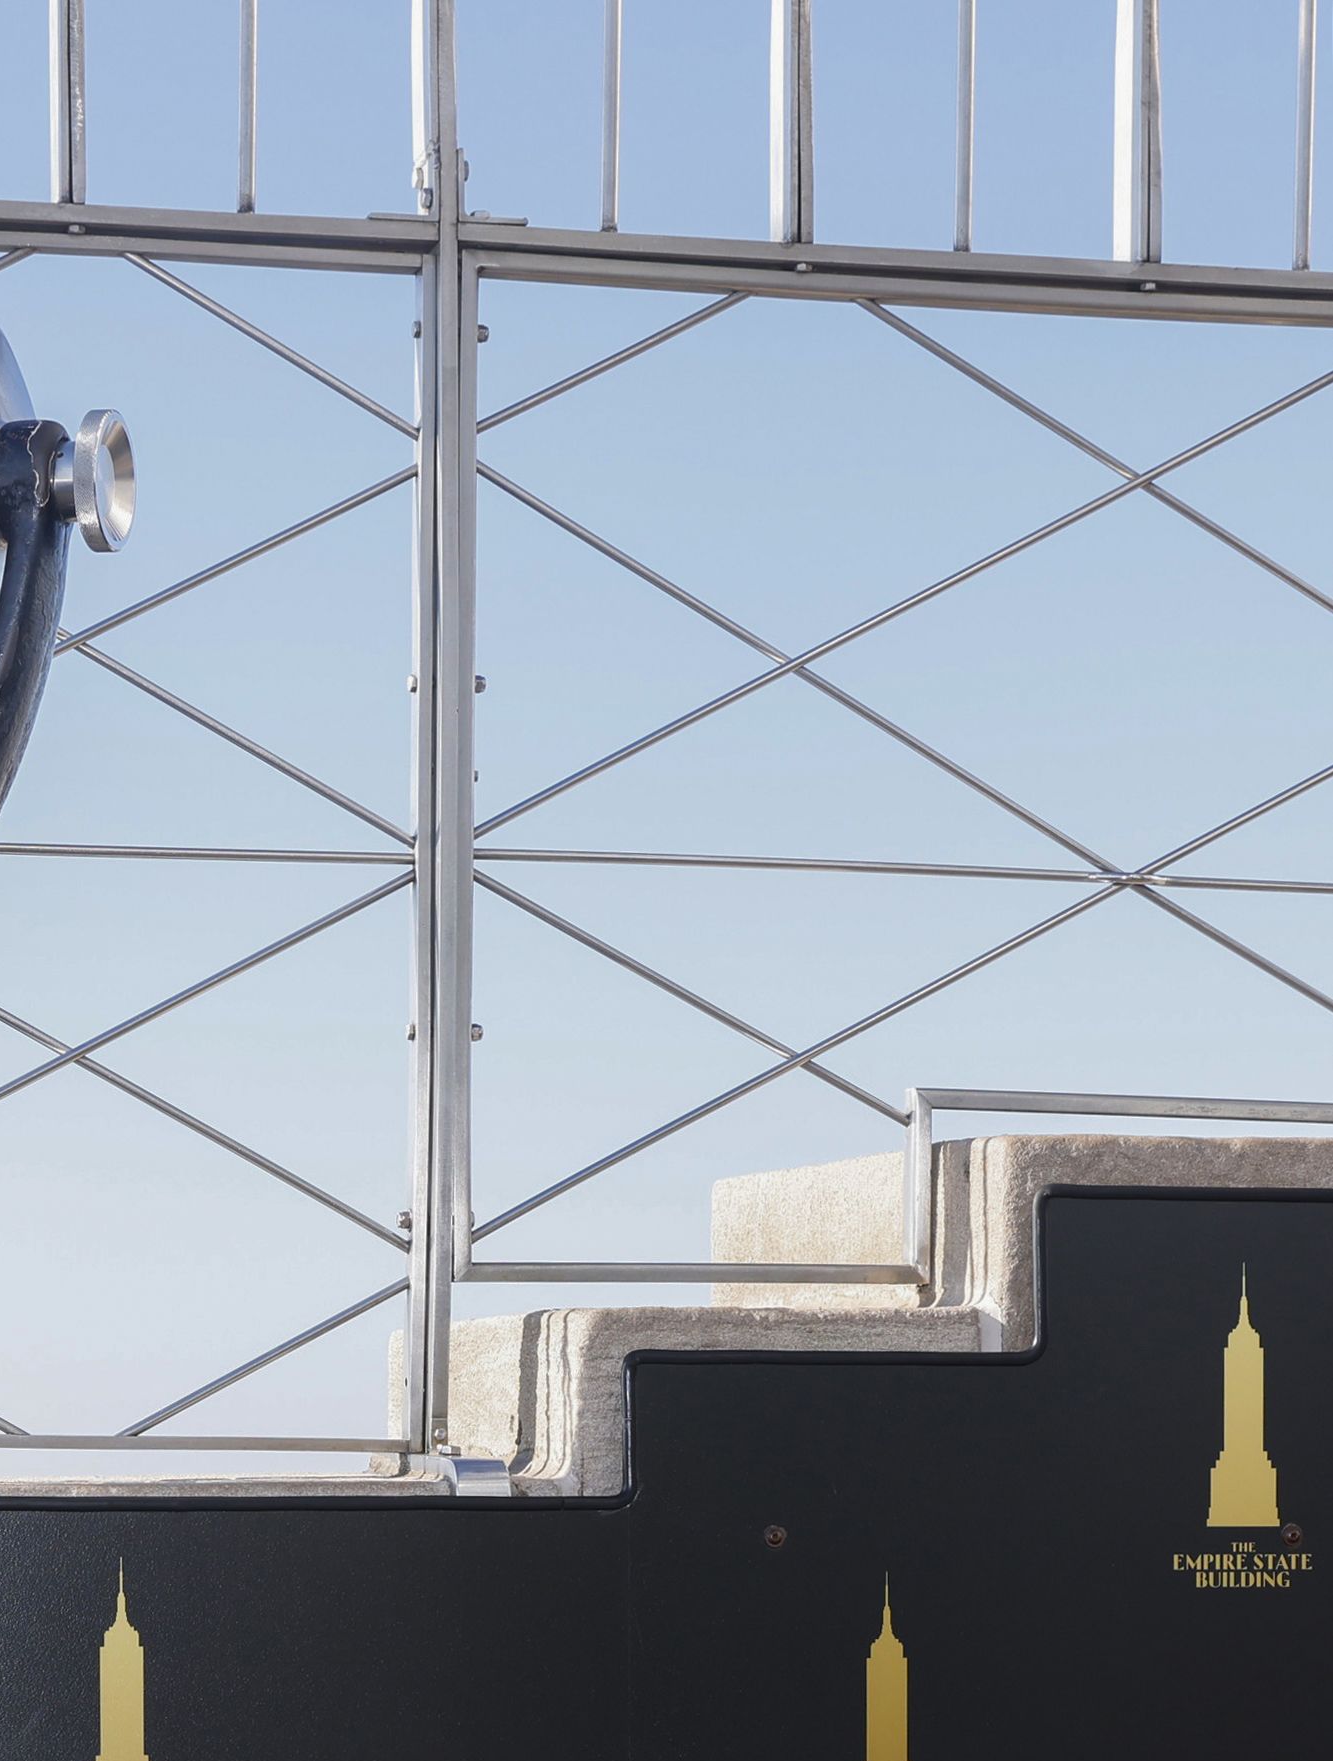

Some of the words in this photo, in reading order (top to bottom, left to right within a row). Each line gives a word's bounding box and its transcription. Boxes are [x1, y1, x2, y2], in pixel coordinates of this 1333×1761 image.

[1231, 1541, 1256, 1553] THE
[1172, 1553, 1248, 1571] EMPIRE
[1253, 1552, 1313, 1570] STATE
[1195, 1569, 1292, 1588] BUILDING
